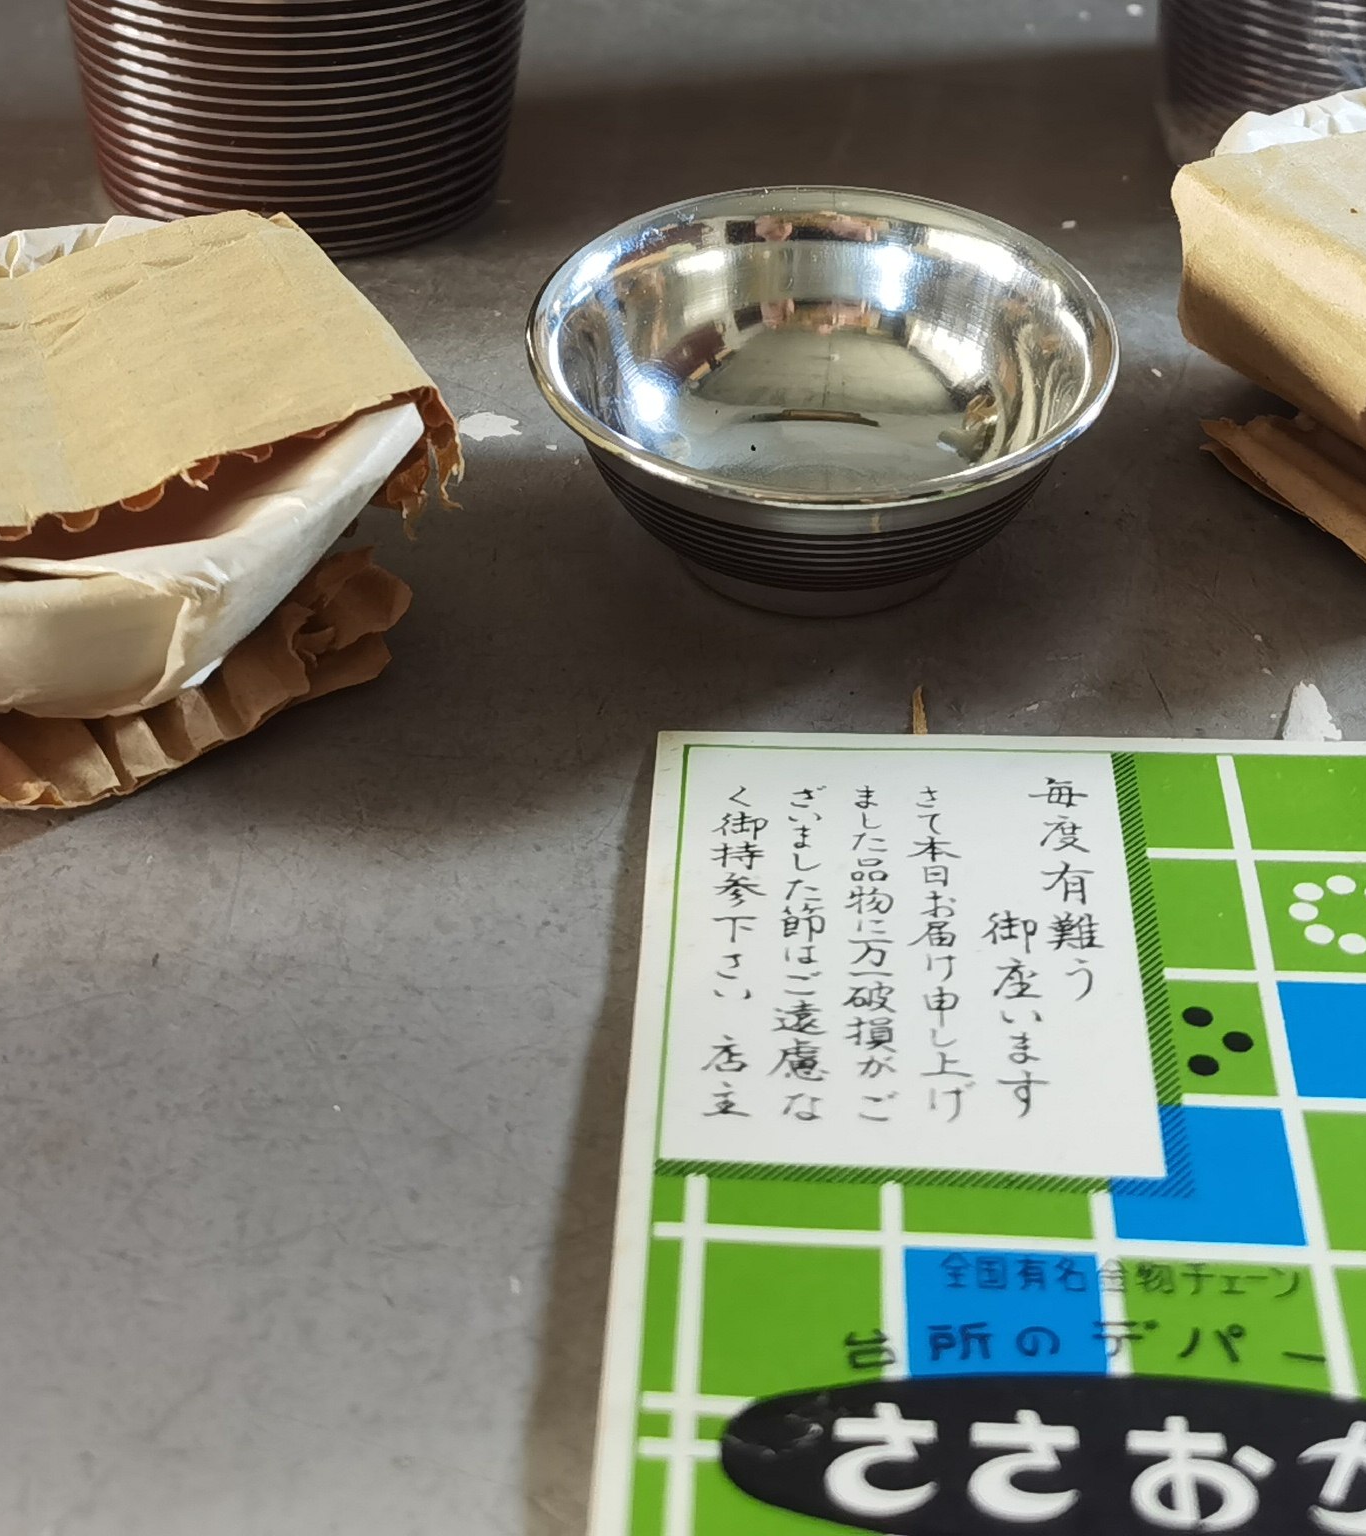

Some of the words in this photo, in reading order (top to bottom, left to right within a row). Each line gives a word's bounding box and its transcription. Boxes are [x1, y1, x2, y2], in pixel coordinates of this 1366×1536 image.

[710, 785, 769, 1001] く御持参下さい
[767, 784, 830, 1123] ざいました節はご遠慮な
[842, 783, 897, 1122] ました品物に万一破損がご
[907, 784, 975, 1124] さて本日お届け申し上げ
[1028, 775, 1105, 1002] 毎度有難う
[700, 1034, 753, 1120] 店主
[981, 908, 1050, 1120] 御座います
[941, 1252, 1300, 1298] 全国有名金物チェーン
